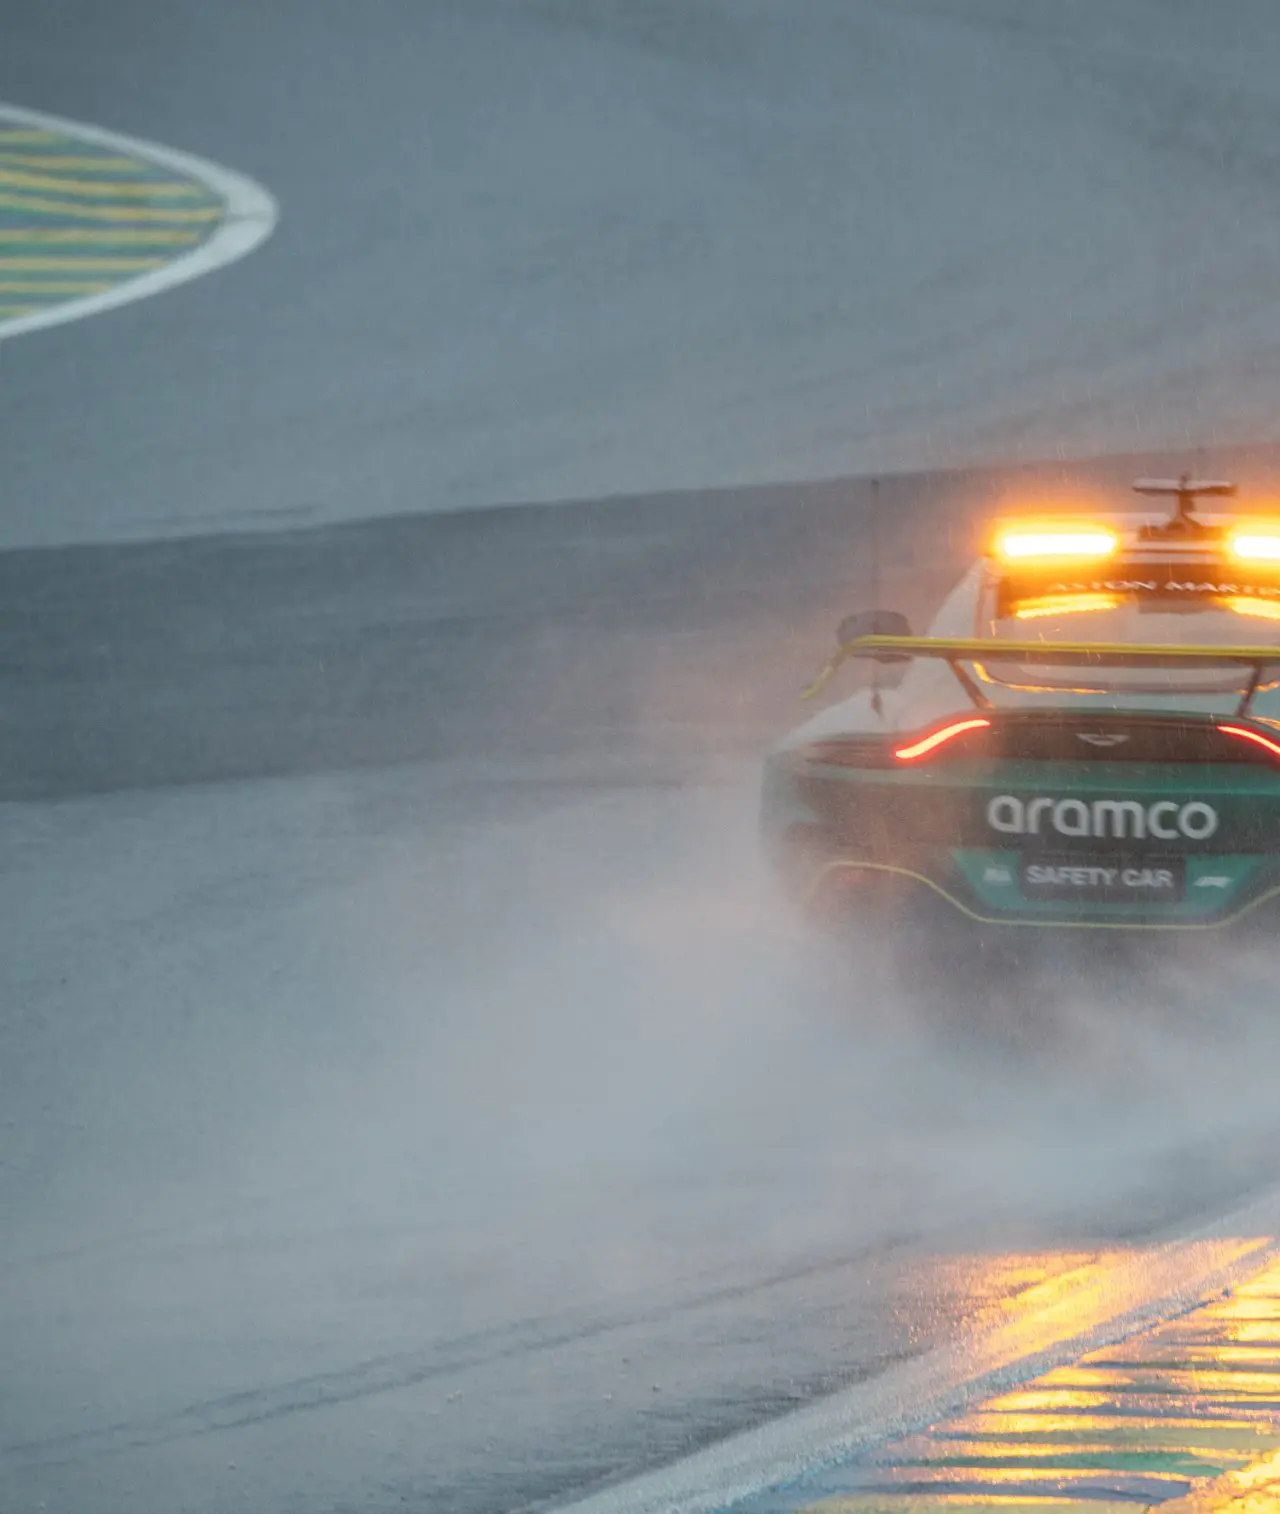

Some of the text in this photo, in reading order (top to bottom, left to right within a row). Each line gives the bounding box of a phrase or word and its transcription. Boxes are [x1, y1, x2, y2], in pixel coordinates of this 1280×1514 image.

[987, 795, 1219, 840] aramco
[1026, 865, 1116, 887] SAFETY
[1121, 868, 1174, 888] CAR
